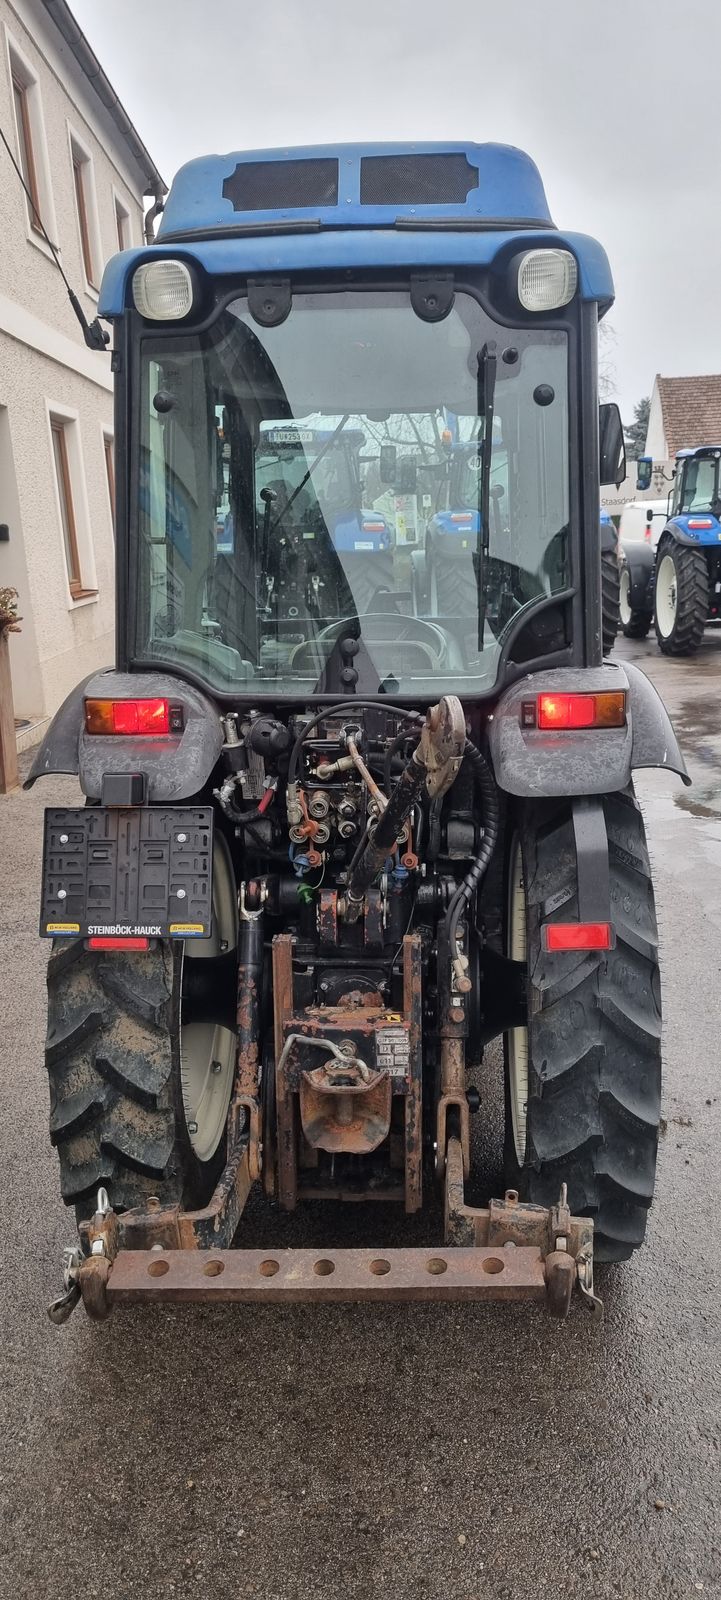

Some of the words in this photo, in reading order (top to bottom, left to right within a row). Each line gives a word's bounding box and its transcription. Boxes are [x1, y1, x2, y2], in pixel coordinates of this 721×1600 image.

[470, 457, 481, 468] 40
[601, 495, 637, 507] Staasdorf
[87, 924, 162, 935] STEINBÖCK-HAUCK
